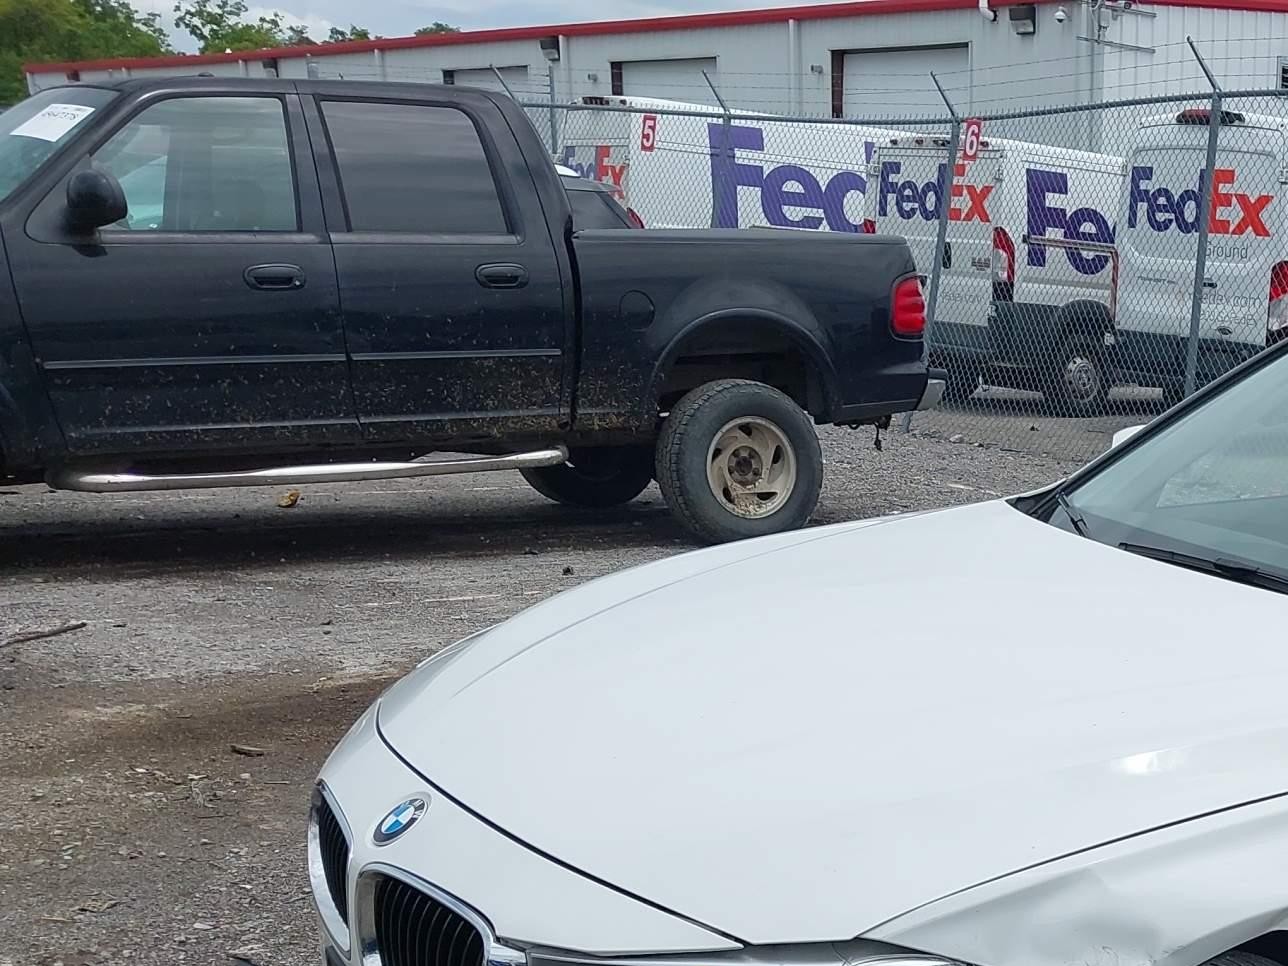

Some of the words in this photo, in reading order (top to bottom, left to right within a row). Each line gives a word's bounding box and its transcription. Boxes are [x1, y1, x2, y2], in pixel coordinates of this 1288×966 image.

[642, 119, 655, 147] 5
[965, 125, 978, 156] 6
[878, 161, 994, 223] FedEx
[1128, 166, 1274, 238] FedEx
